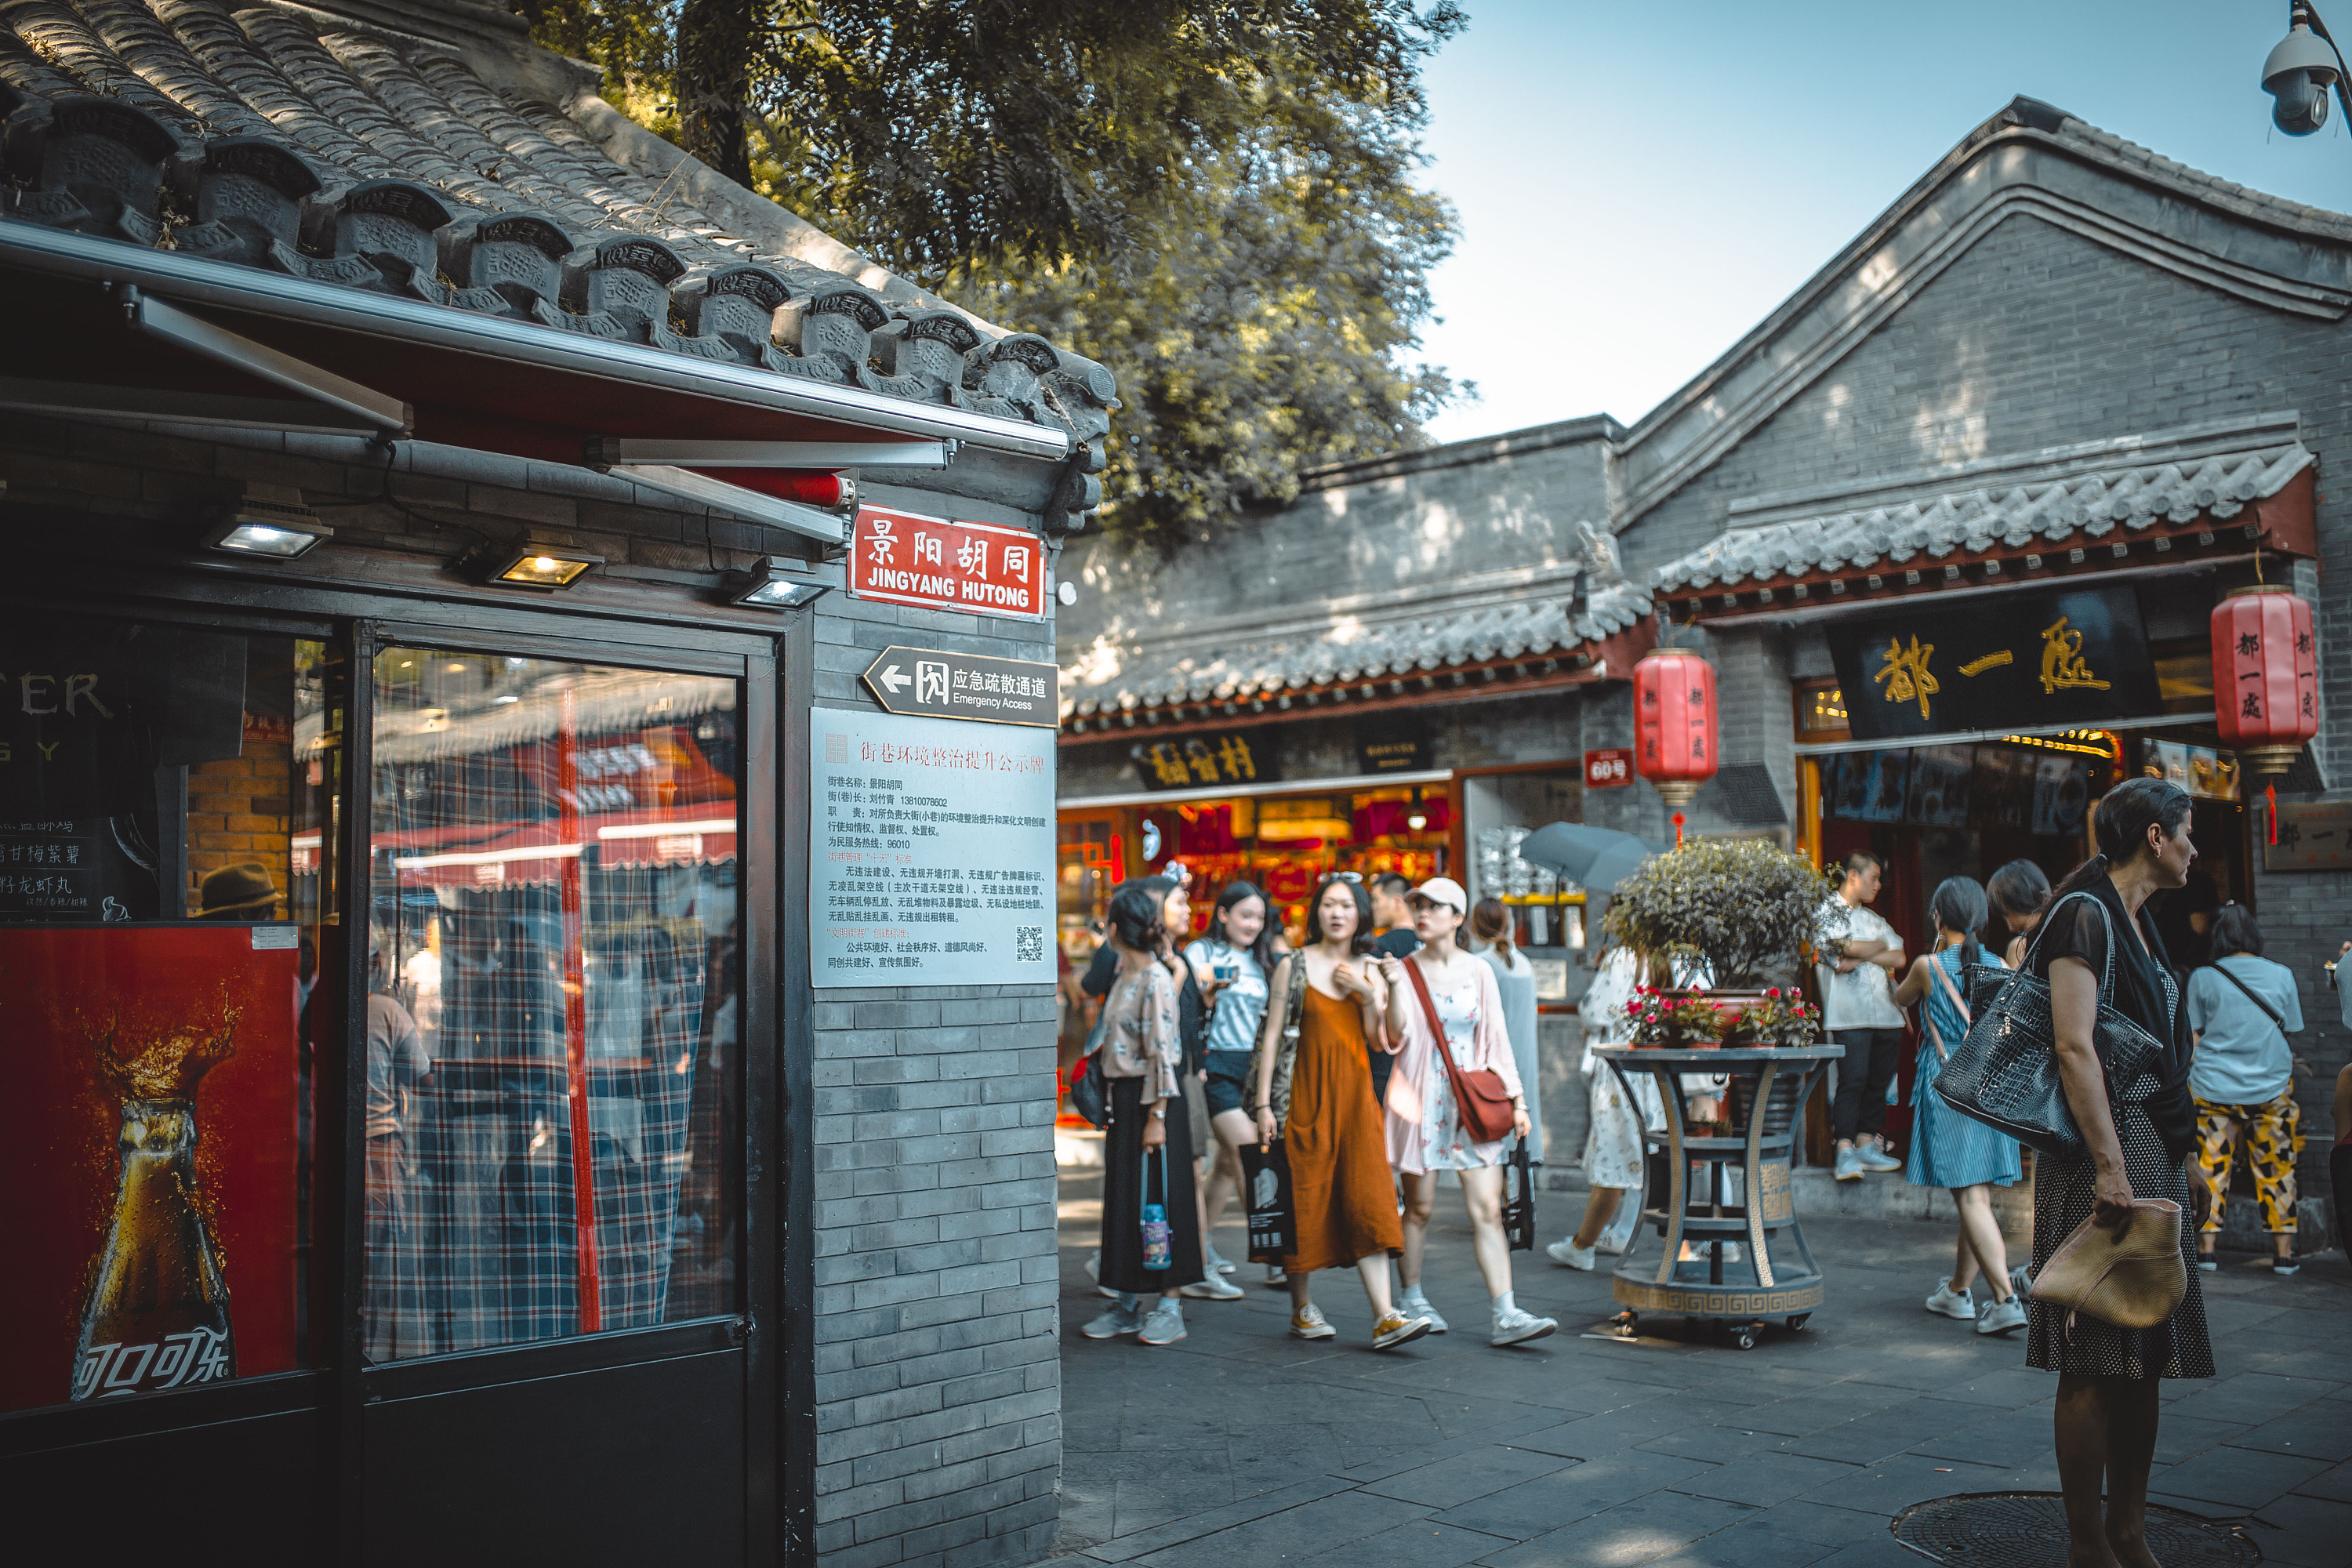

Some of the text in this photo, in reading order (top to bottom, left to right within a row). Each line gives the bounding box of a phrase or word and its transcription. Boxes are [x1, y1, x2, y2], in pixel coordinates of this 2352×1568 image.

[864, 519, 1030, 584] 景阳胡同
[867, 567, 1029, 608] JINGYANG HUTONG
[0, 670, 115, 720] ER
[952, 669, 1047, 698] 应急疏散通道
[953, 692, 1033, 710] Emergency Access
[862, 741, 1045, 775] 街巷环境整治提升公示牌
[1591, 760, 1626, 780] 60号
[2278, 821, 2352, 853] 都一
[78, 1326, 228, 1399] 可口可乐
